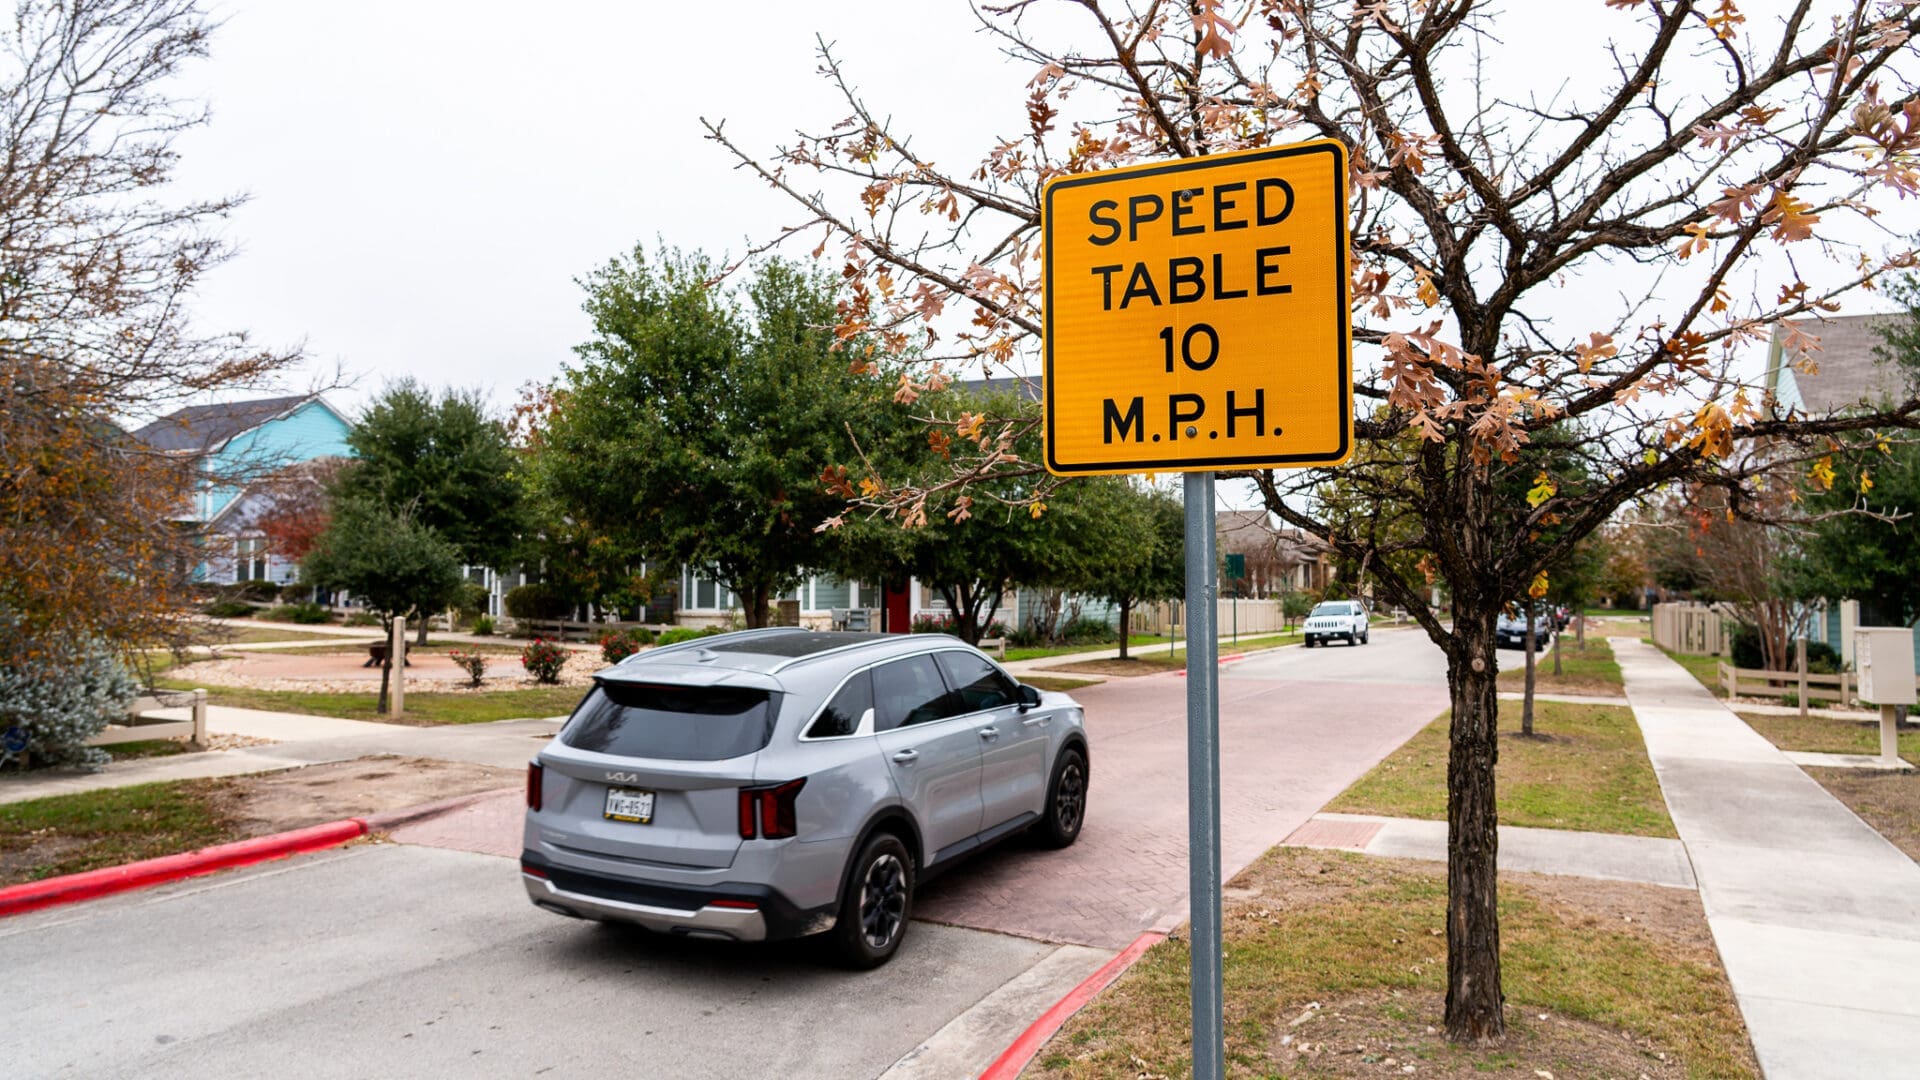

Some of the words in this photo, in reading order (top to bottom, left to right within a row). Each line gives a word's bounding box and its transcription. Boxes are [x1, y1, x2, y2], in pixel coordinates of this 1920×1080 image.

[1088, 178, 1294, 245] SPEED
[1092, 246, 1292, 310] TABLE
[1160, 324, 1219, 372] 10
[1104, 389, 1282, 444] M.P.H.
